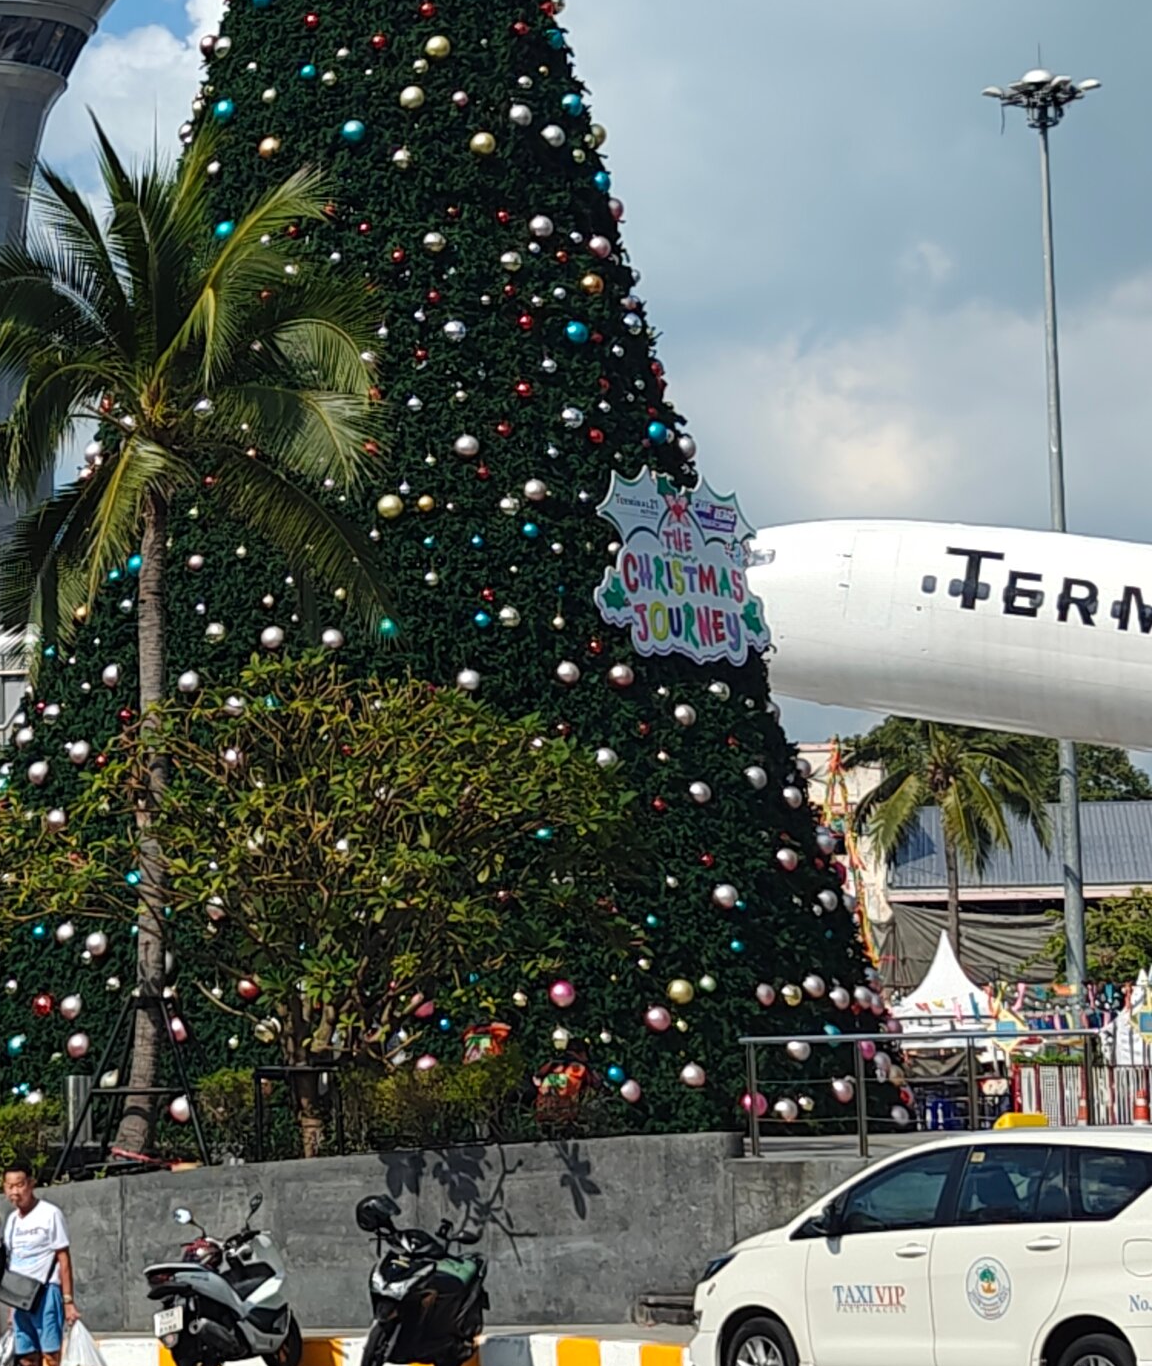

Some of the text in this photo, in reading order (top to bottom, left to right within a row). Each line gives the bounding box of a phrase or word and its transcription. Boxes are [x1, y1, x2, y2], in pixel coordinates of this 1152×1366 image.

[662, 528, 692, 552] THE
[623, 553, 744, 603] CHRISTMAS
[633, 600, 741, 652] JOURNEY
[832, 1285, 906, 1306] TAXI VIP
